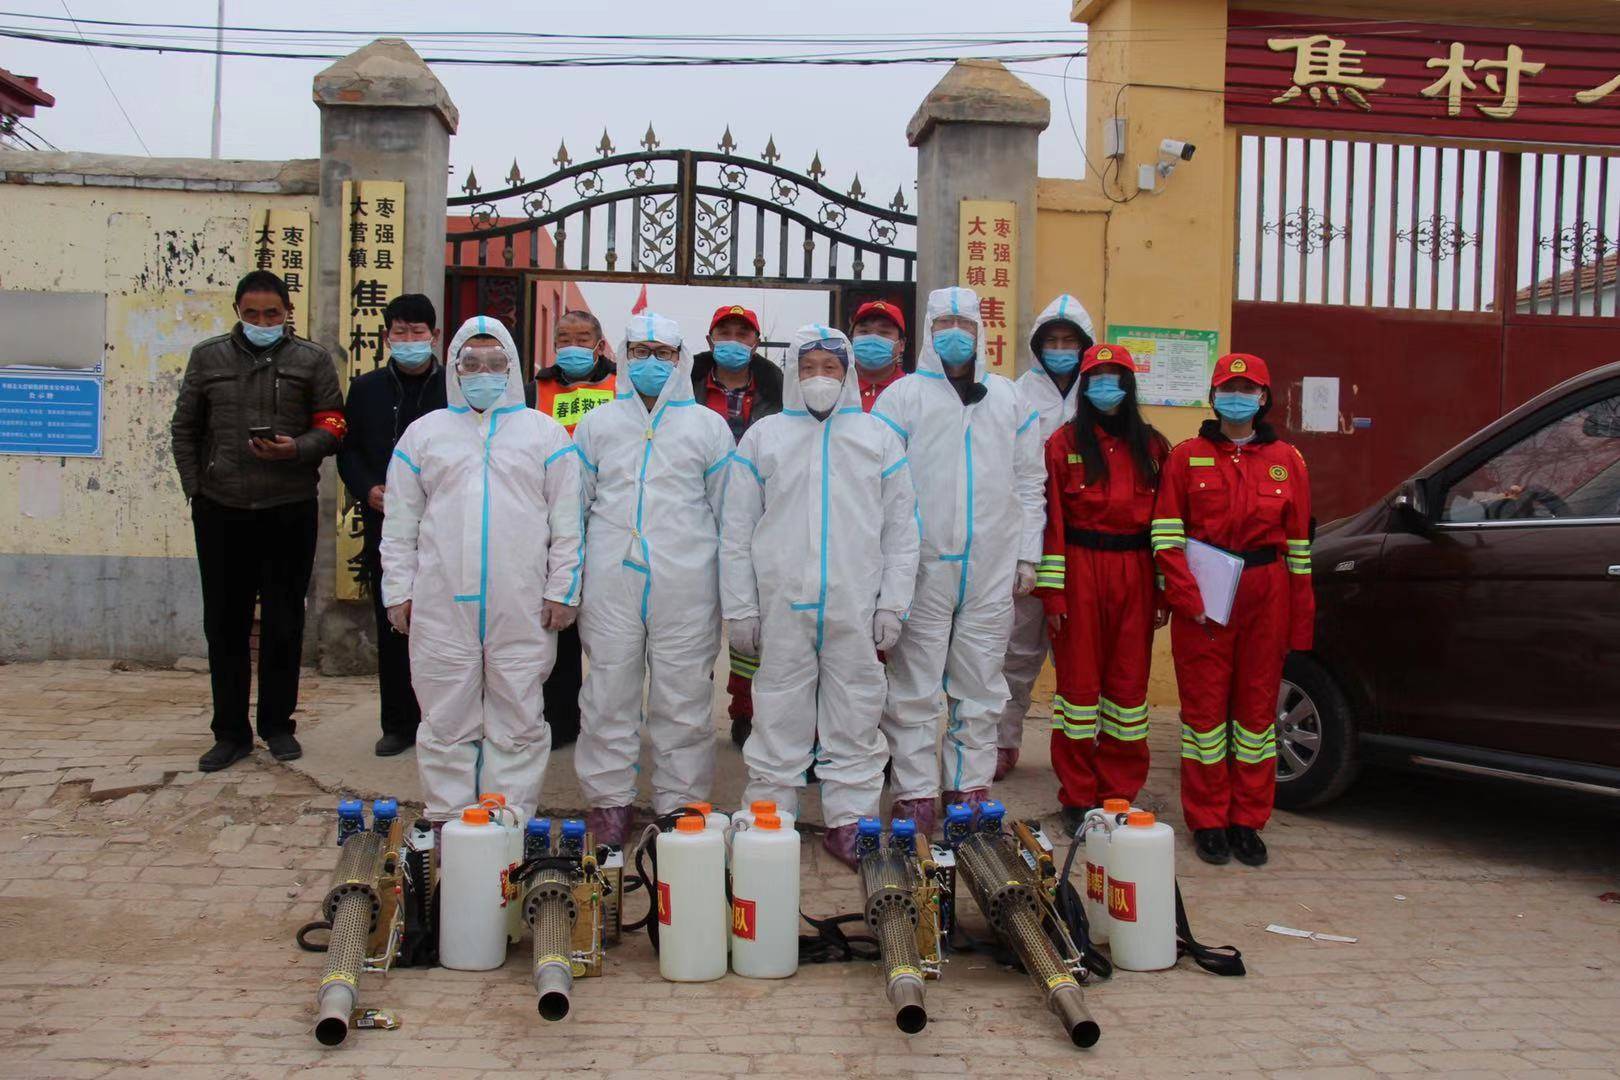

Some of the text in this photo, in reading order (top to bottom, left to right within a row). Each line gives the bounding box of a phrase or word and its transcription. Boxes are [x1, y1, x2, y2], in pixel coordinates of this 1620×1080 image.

[282, 226, 304, 293] 枣强县
[348, 196, 369, 268] 大营镇
[374, 198, 395, 270] 枣强县
[966, 216, 987, 286] 大营镇
[992, 218, 1011, 288] 枣强县
